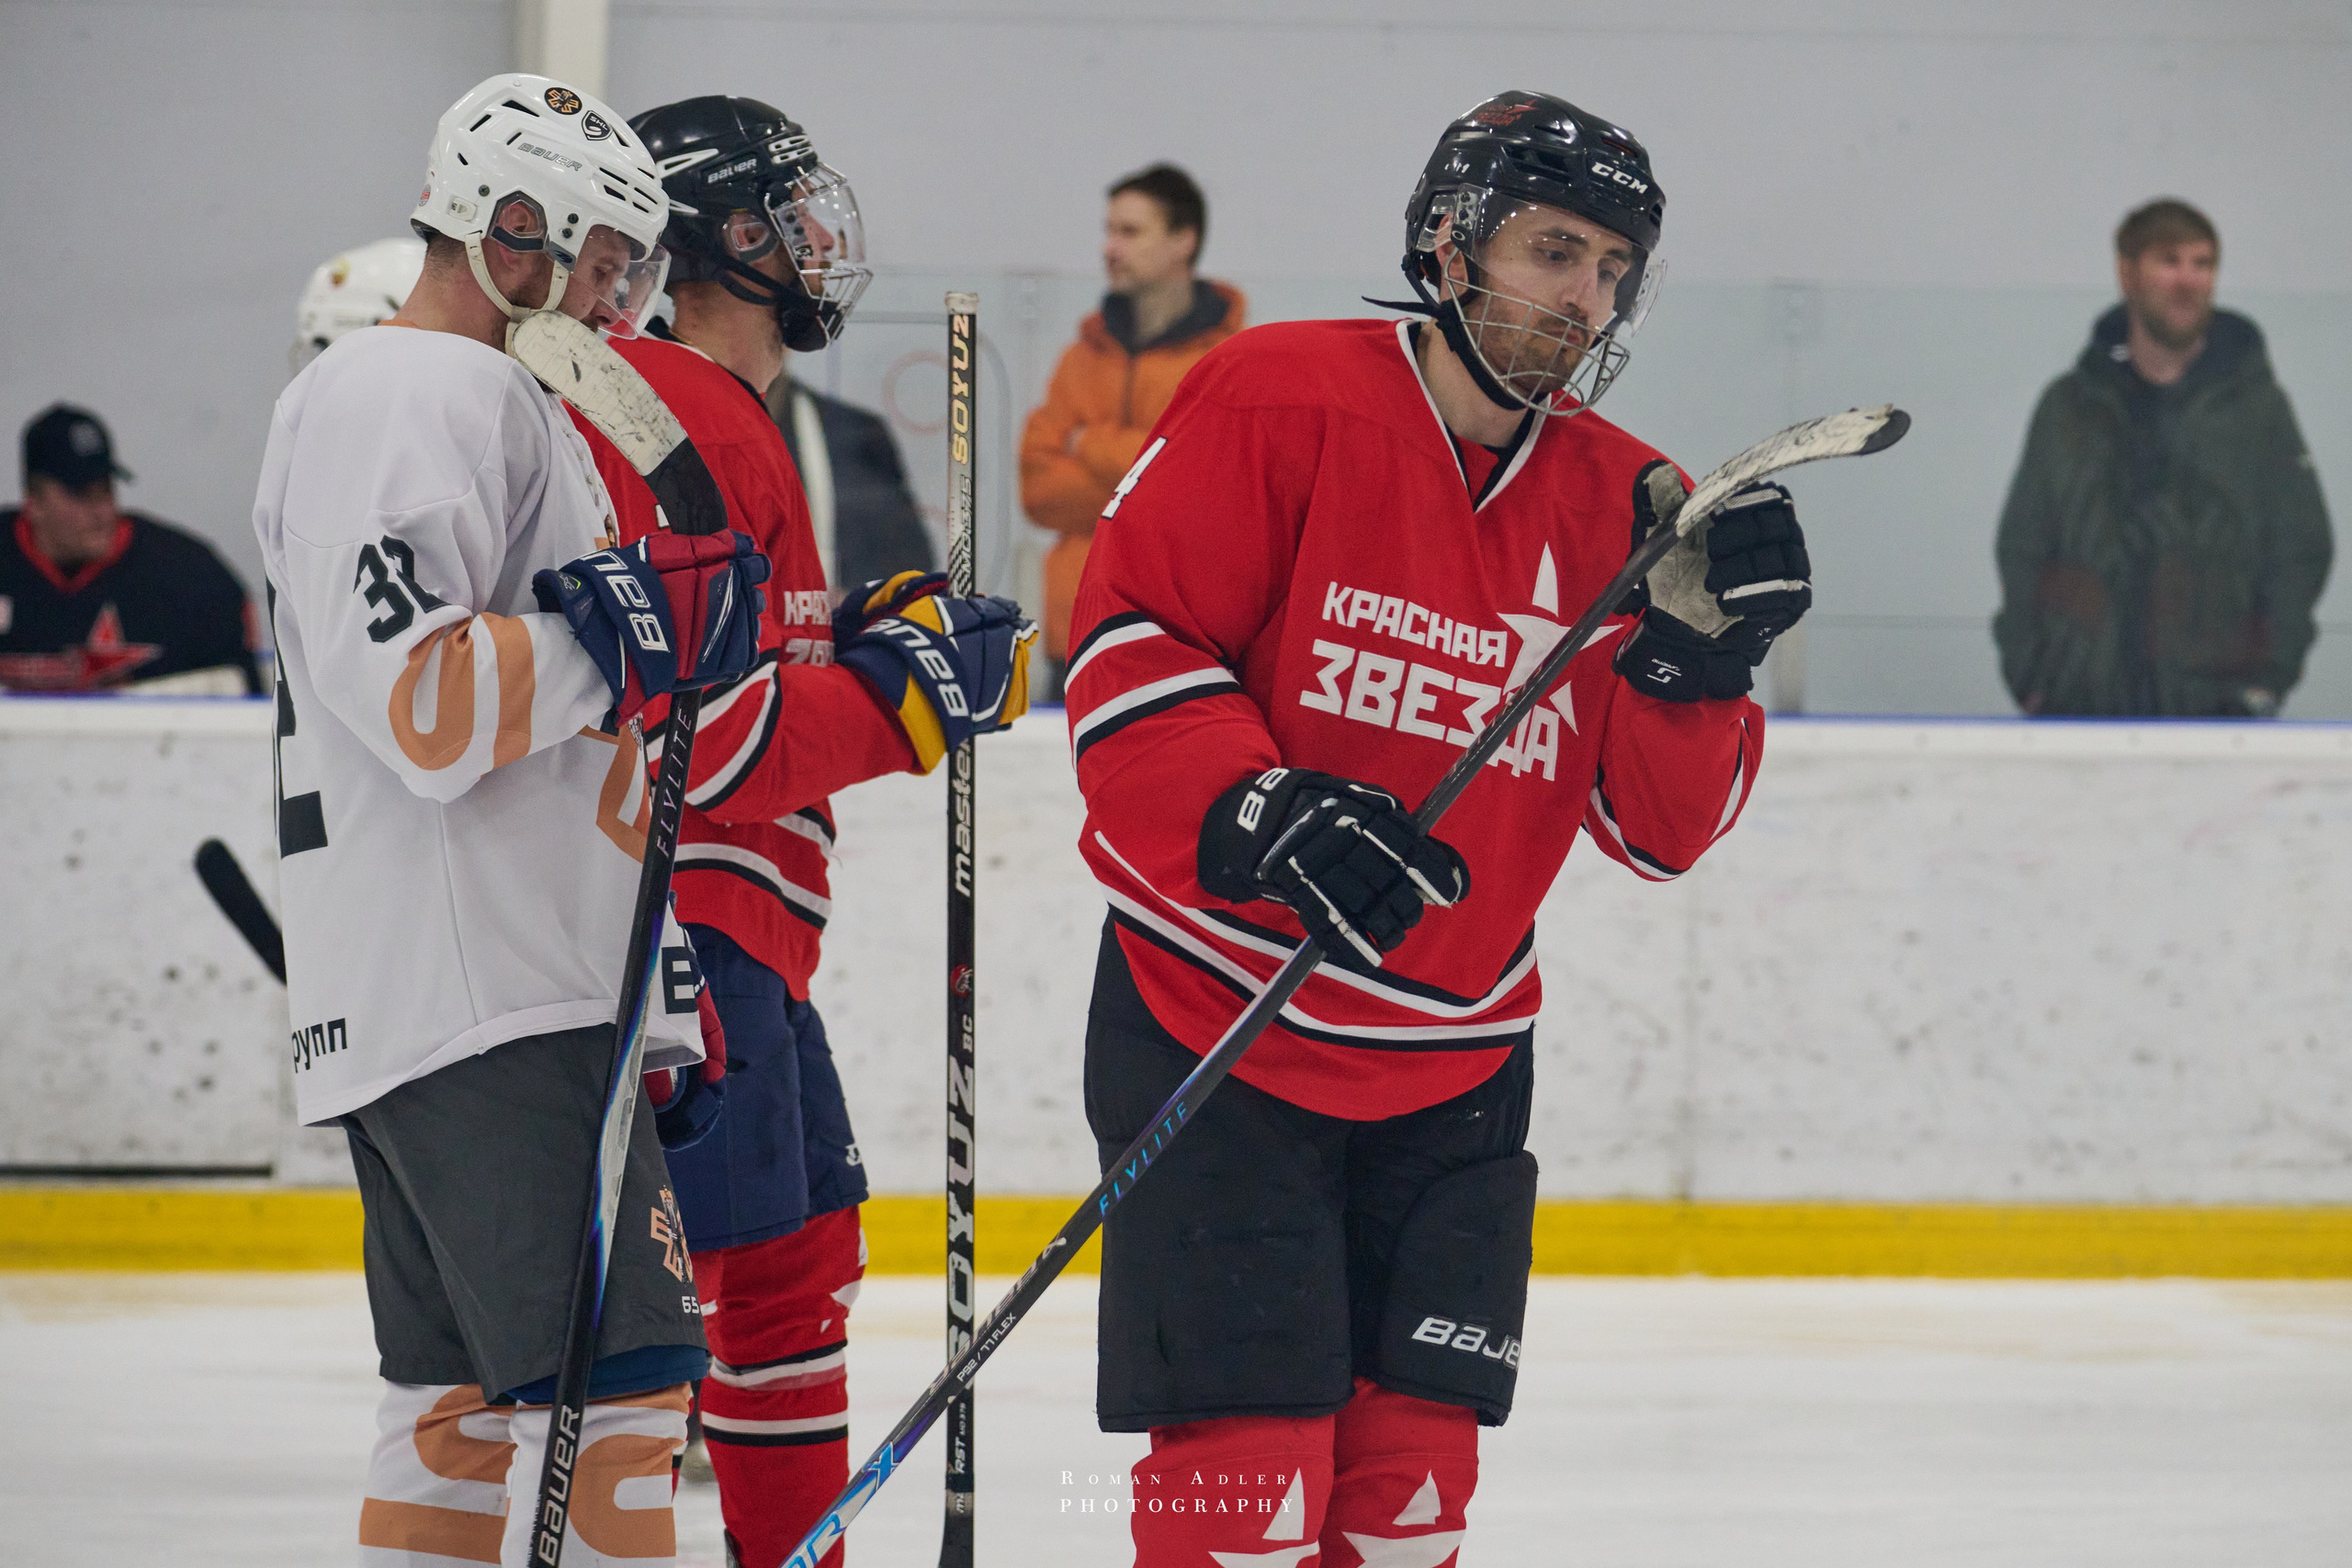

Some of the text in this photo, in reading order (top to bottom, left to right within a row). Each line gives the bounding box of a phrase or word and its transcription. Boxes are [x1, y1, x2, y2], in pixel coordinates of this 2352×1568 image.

[1590, 162, 1648, 195] CCM
[951, 314, 970, 466] SOYUZ
[353, 534, 453, 643] 32
[1321, 581, 1509, 668] КРАСНАЯ
[656, 707, 693, 859] FLYLITE
[1099, 1100, 1188, 1219] FLYLITE
[956, 1359, 978, 1382] P92
[991, 1312, 1016, 1341] FLEX
[955, 1436, 967, 1474] RST
